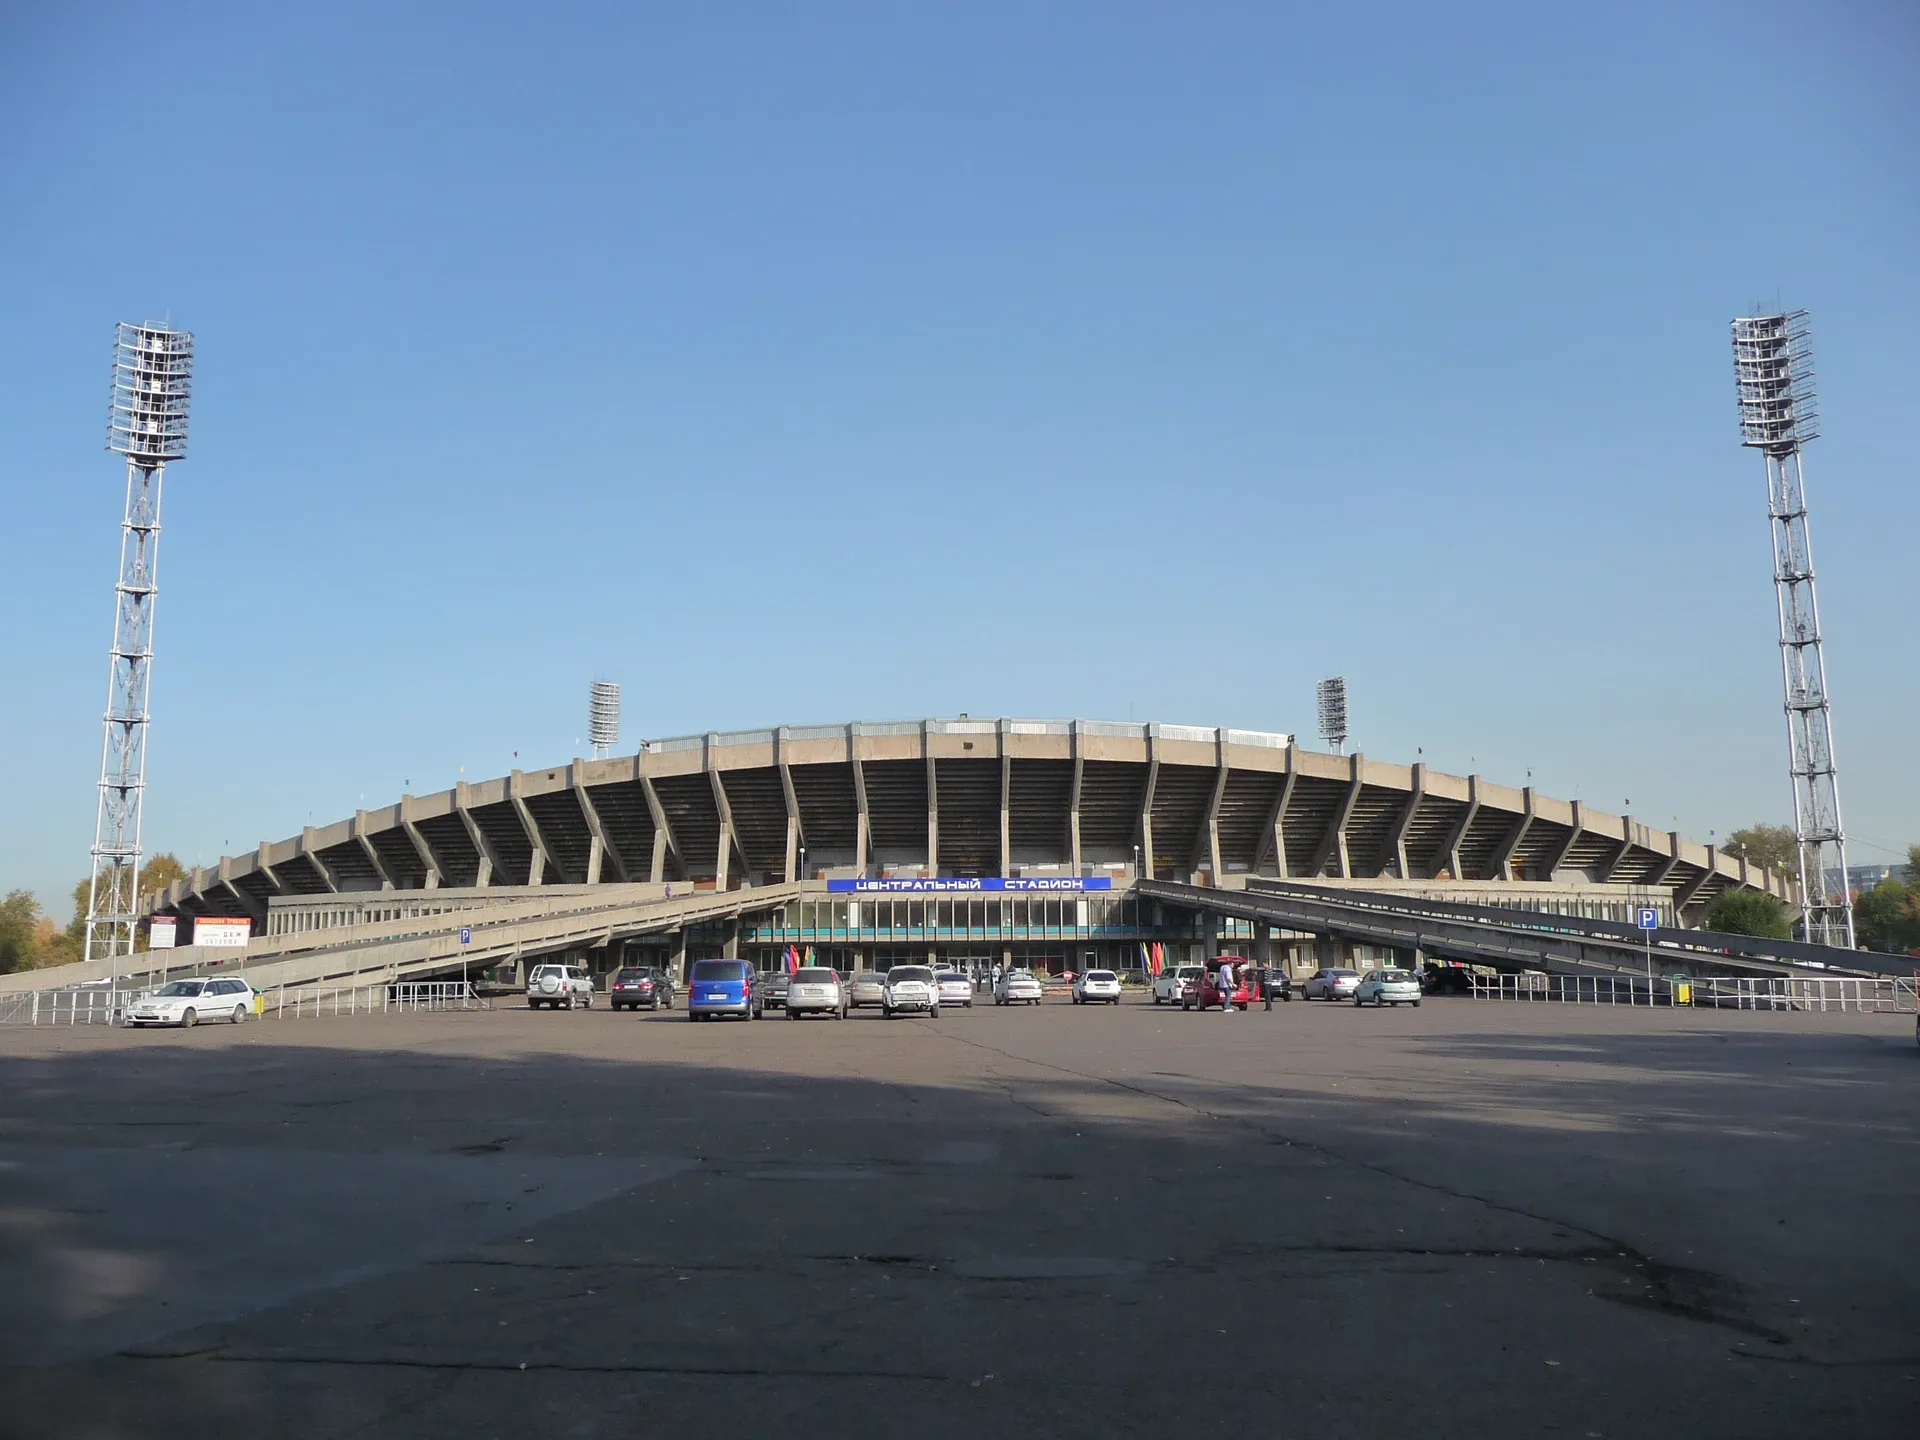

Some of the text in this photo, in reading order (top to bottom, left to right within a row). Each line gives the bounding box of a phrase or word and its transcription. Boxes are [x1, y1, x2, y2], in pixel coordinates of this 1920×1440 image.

[856, 878, 1083, 890] ЦЕНТРАЛЬНЫЙ СТАДИОН
[1643, 911, 1653, 926] P
[462, 930, 469, 942] P
